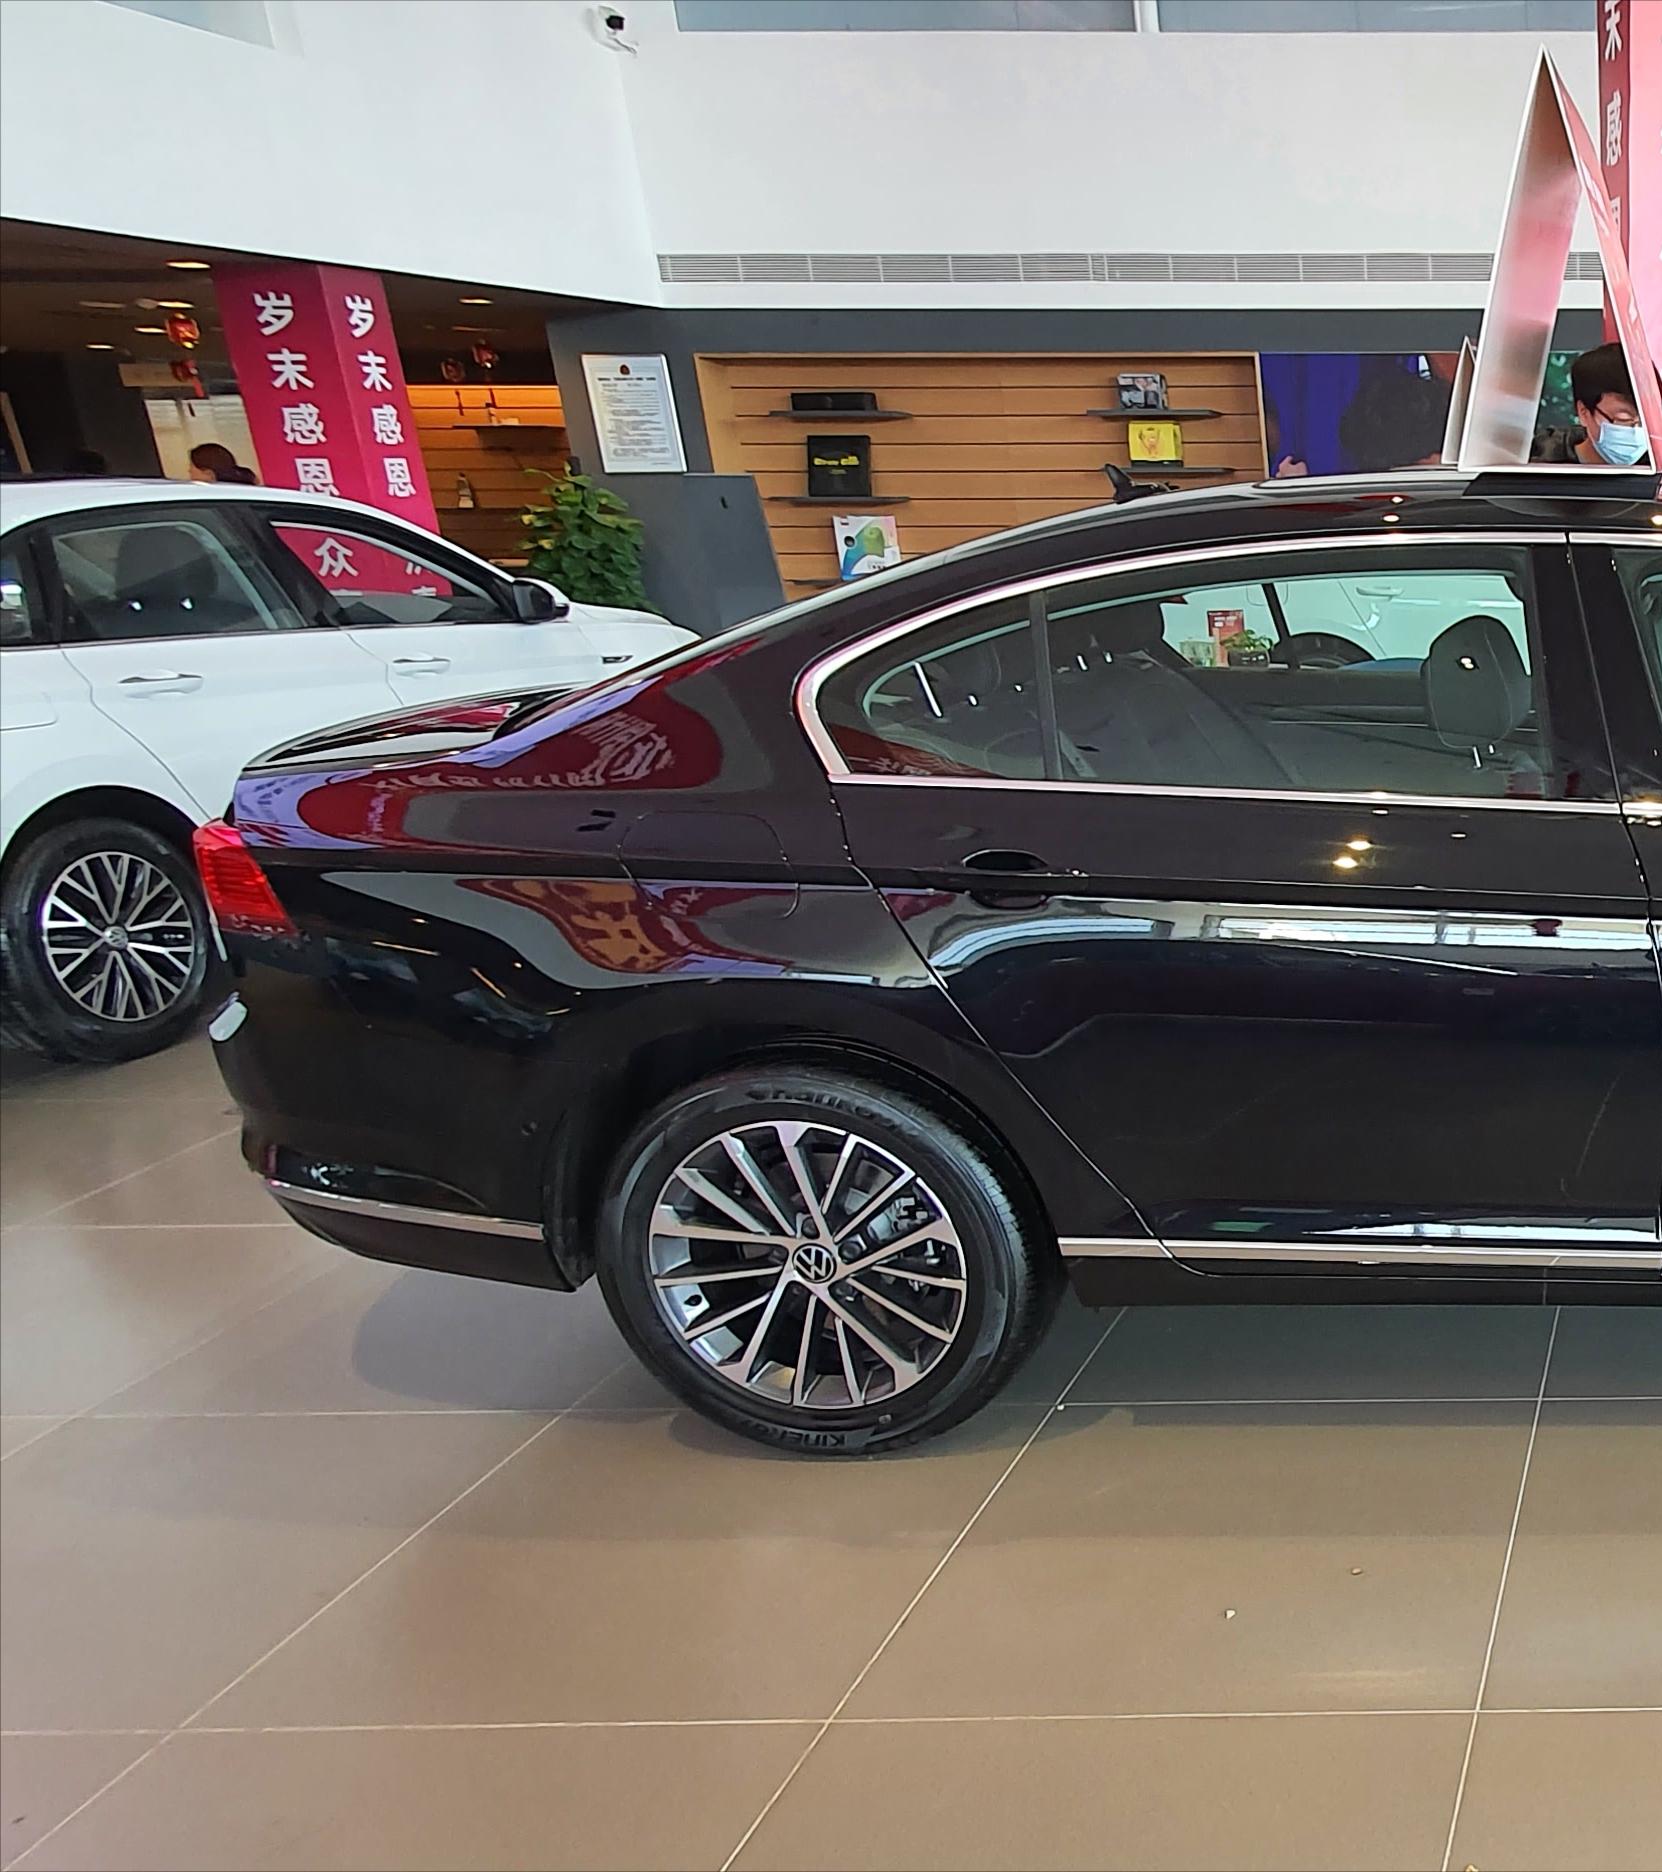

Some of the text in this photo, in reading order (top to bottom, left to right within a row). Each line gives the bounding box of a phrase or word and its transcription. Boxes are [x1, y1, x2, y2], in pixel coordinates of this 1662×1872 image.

[253, 291, 340, 496] 岁末感恩
[345, 294, 416, 497] 岁末感恩
